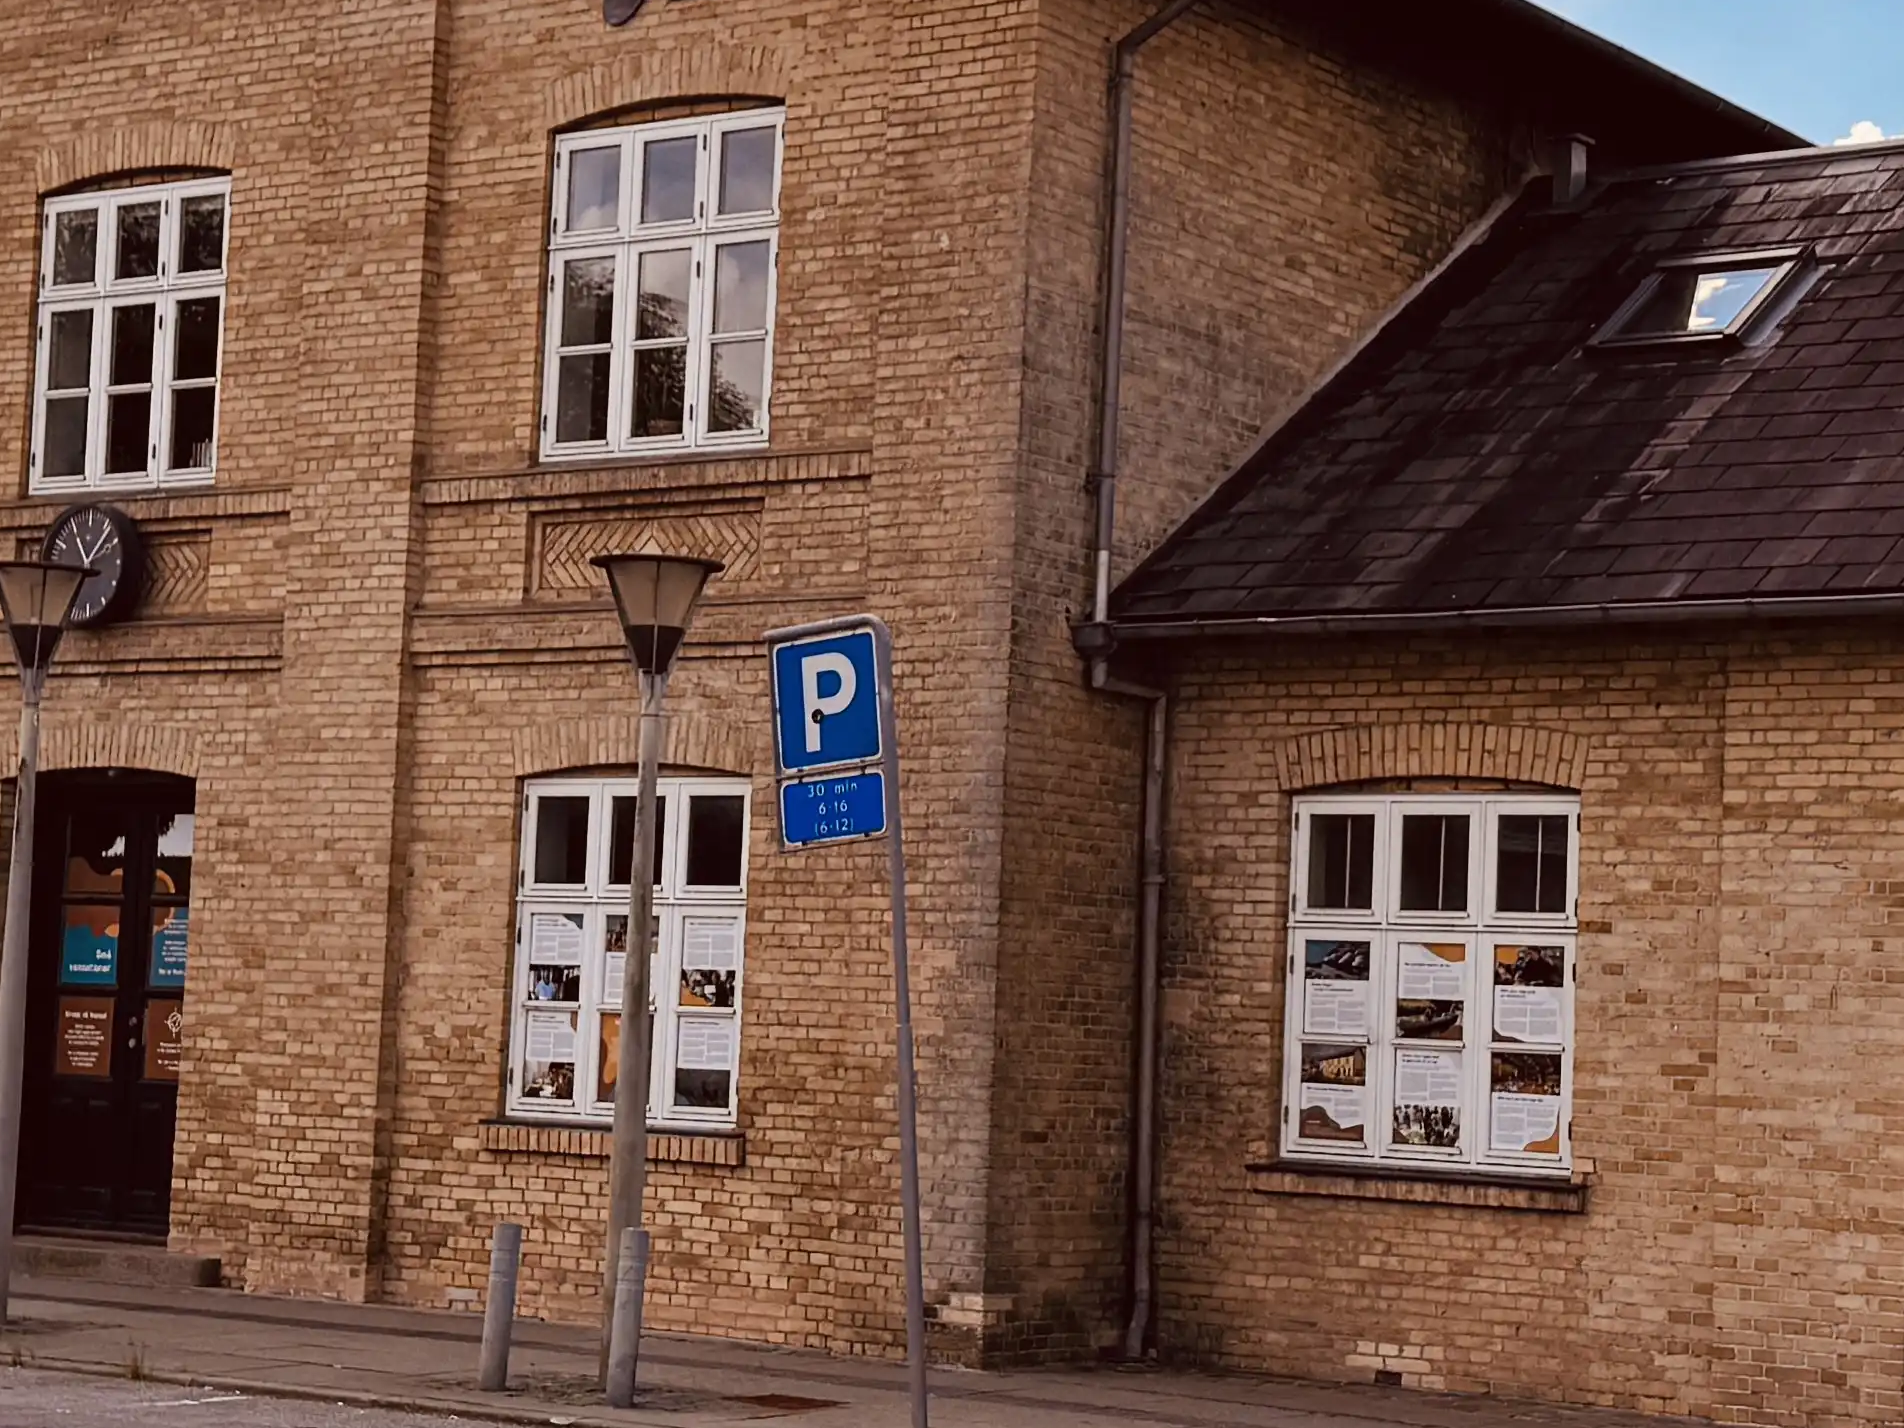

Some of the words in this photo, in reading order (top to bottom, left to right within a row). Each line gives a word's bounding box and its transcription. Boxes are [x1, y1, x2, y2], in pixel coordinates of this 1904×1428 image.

[801, 652, 857, 753] P
[807, 783, 825, 798] 30
[834, 779, 858, 796] min
